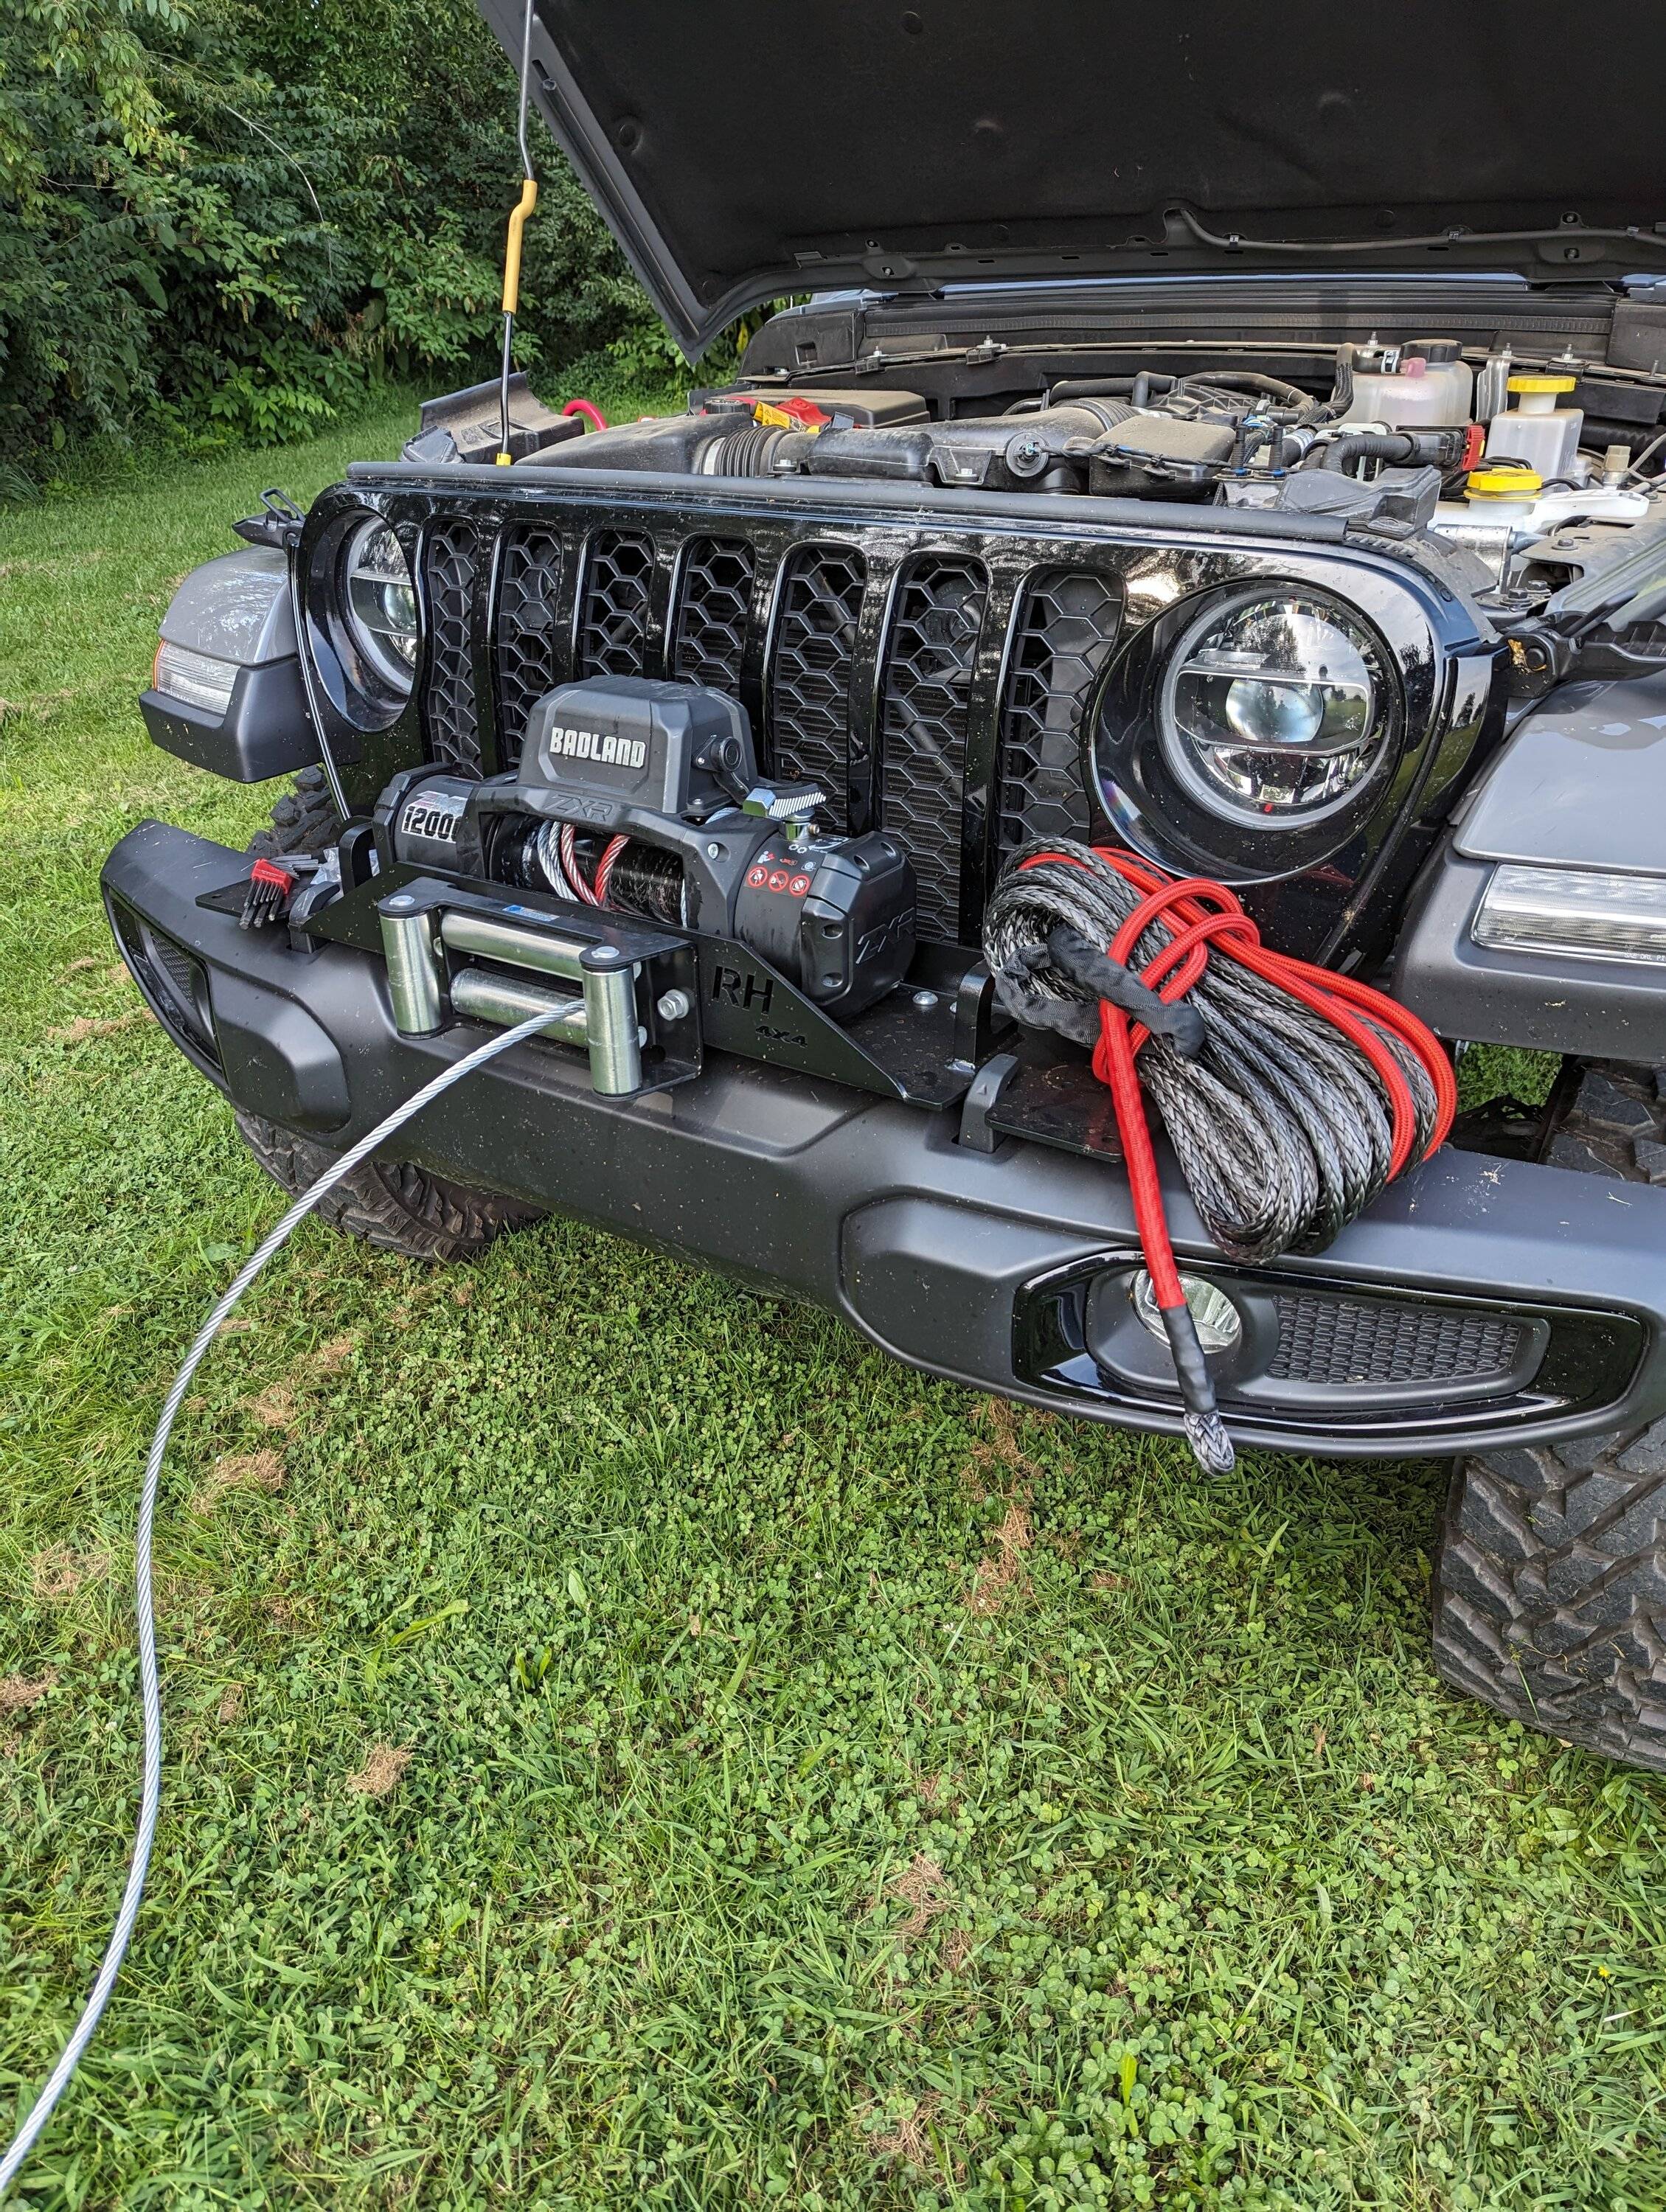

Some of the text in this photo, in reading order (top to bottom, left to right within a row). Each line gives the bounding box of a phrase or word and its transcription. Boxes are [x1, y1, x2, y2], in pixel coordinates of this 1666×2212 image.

[549, 726, 646, 768] BADLAND
[544, 794, 614, 822] ZXR
[712, 965, 774, 1015] RH
